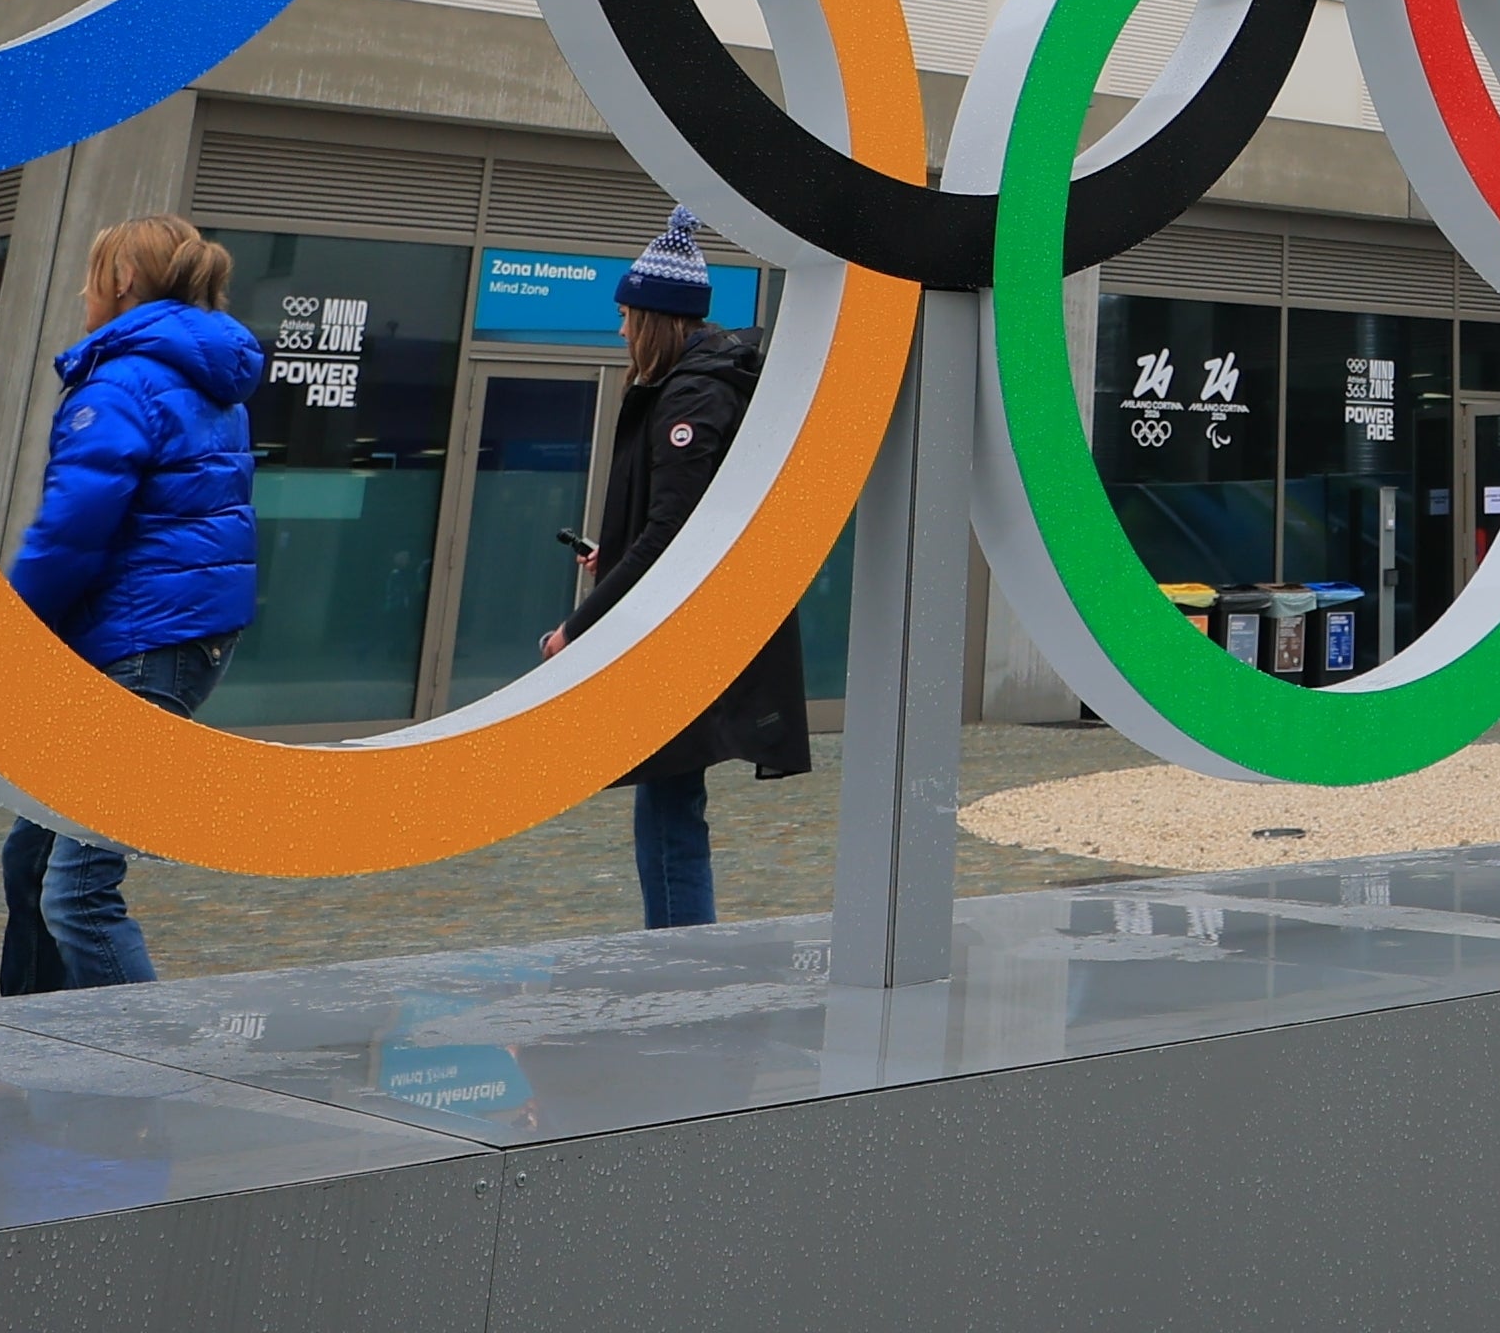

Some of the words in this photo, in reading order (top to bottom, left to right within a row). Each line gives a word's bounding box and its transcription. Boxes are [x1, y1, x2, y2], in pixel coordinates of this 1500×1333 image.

[492, 260, 531, 276] Zona
[534, 263, 596, 281] Mentale
[489, 281, 518, 294] Mind
[521, 283, 549, 296] Zone
[321, 298, 368, 326] MIND
[280, 319, 315, 331] Athlete
[275, 330, 314, 349] 365
[317, 325, 364, 352] ZONE
[269, 360, 359, 385] POWER
[1369, 359, 1394, 380] MIND
[306, 384, 357, 407] ADE
[1345, 383, 1367, 398] 365
[1369, 379, 1394, 400] ZONE
[1120, 399, 1152, 409] MILANO
[1152, 400, 1185, 411] CORTINA
[1188, 402, 1220, 412] MILANO
[1220, 403, 1250, 413] CORTINA
[1345, 406, 1394, 424] POWER
[1367, 423, 1395, 441] ADE
